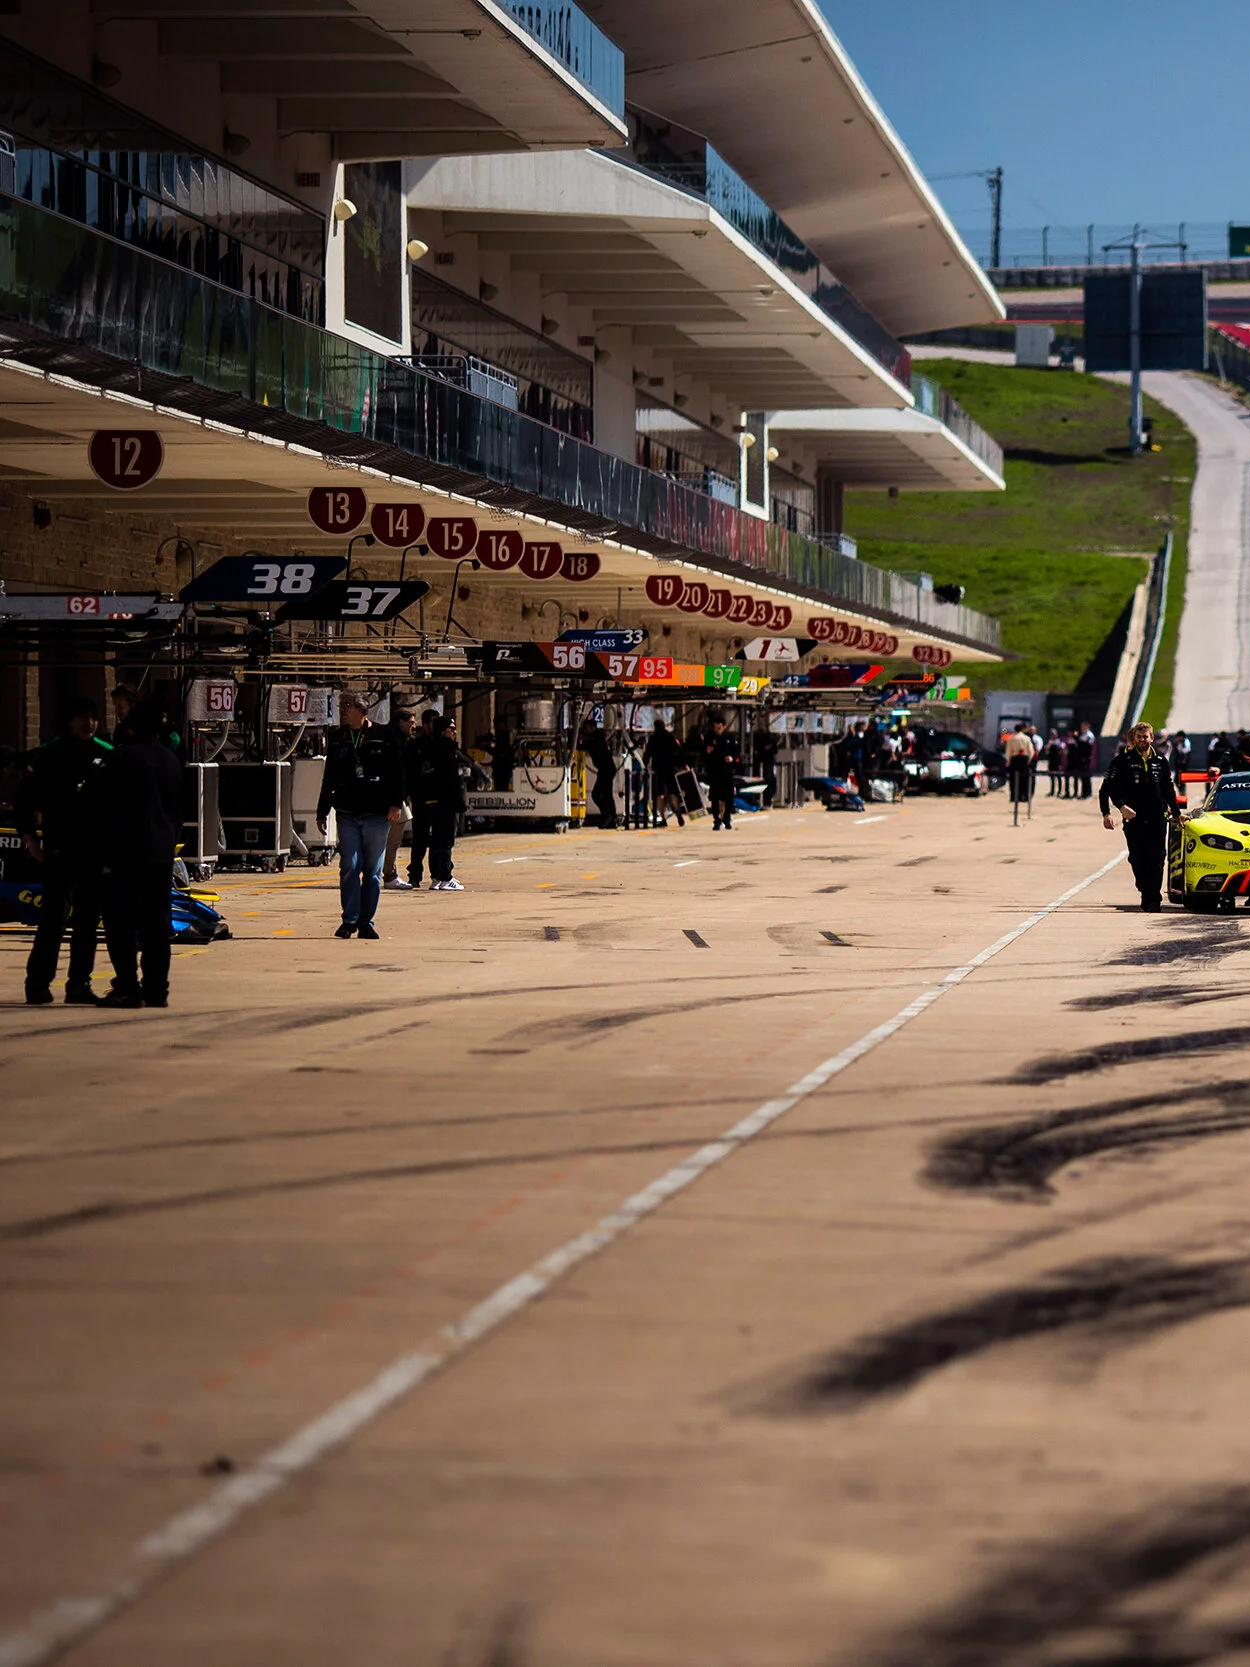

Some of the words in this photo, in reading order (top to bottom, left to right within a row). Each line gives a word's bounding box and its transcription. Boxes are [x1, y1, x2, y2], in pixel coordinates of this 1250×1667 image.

[111, 437, 141, 476] 12
[326, 492, 350, 524] 13
[385, 508, 409, 538] 14
[441, 523, 463, 550] 15
[489, 535, 510, 562] 16
[531, 546, 549, 572] 17
[570, 557, 588, 575] 18
[247, 563, 316, 594] 38
[656, 579, 674, 600] 19
[682, 586, 700, 607] 20
[70, 596, 96, 614] 62
[341, 587, 401, 615] 37
[707, 593, 722, 612] 21
[623, 629, 644, 644] 33
[814, 619, 829, 637] 25
[592, 639, 616, 647] CLASS
[758, 639, 772, 659] 1
[552, 645, 585, 670] 56
[608, 655, 638, 677] 57
[643, 659, 667, 677] 95
[677, 667, 699, 683] 98
[713, 668, 734, 684] 97
[743, 678, 758, 693] 29
[785, 675, 800, 685] 42
[922, 673, 935, 683] 86
[210, 687, 233, 711] 56
[290, 689, 307, 712] 57
